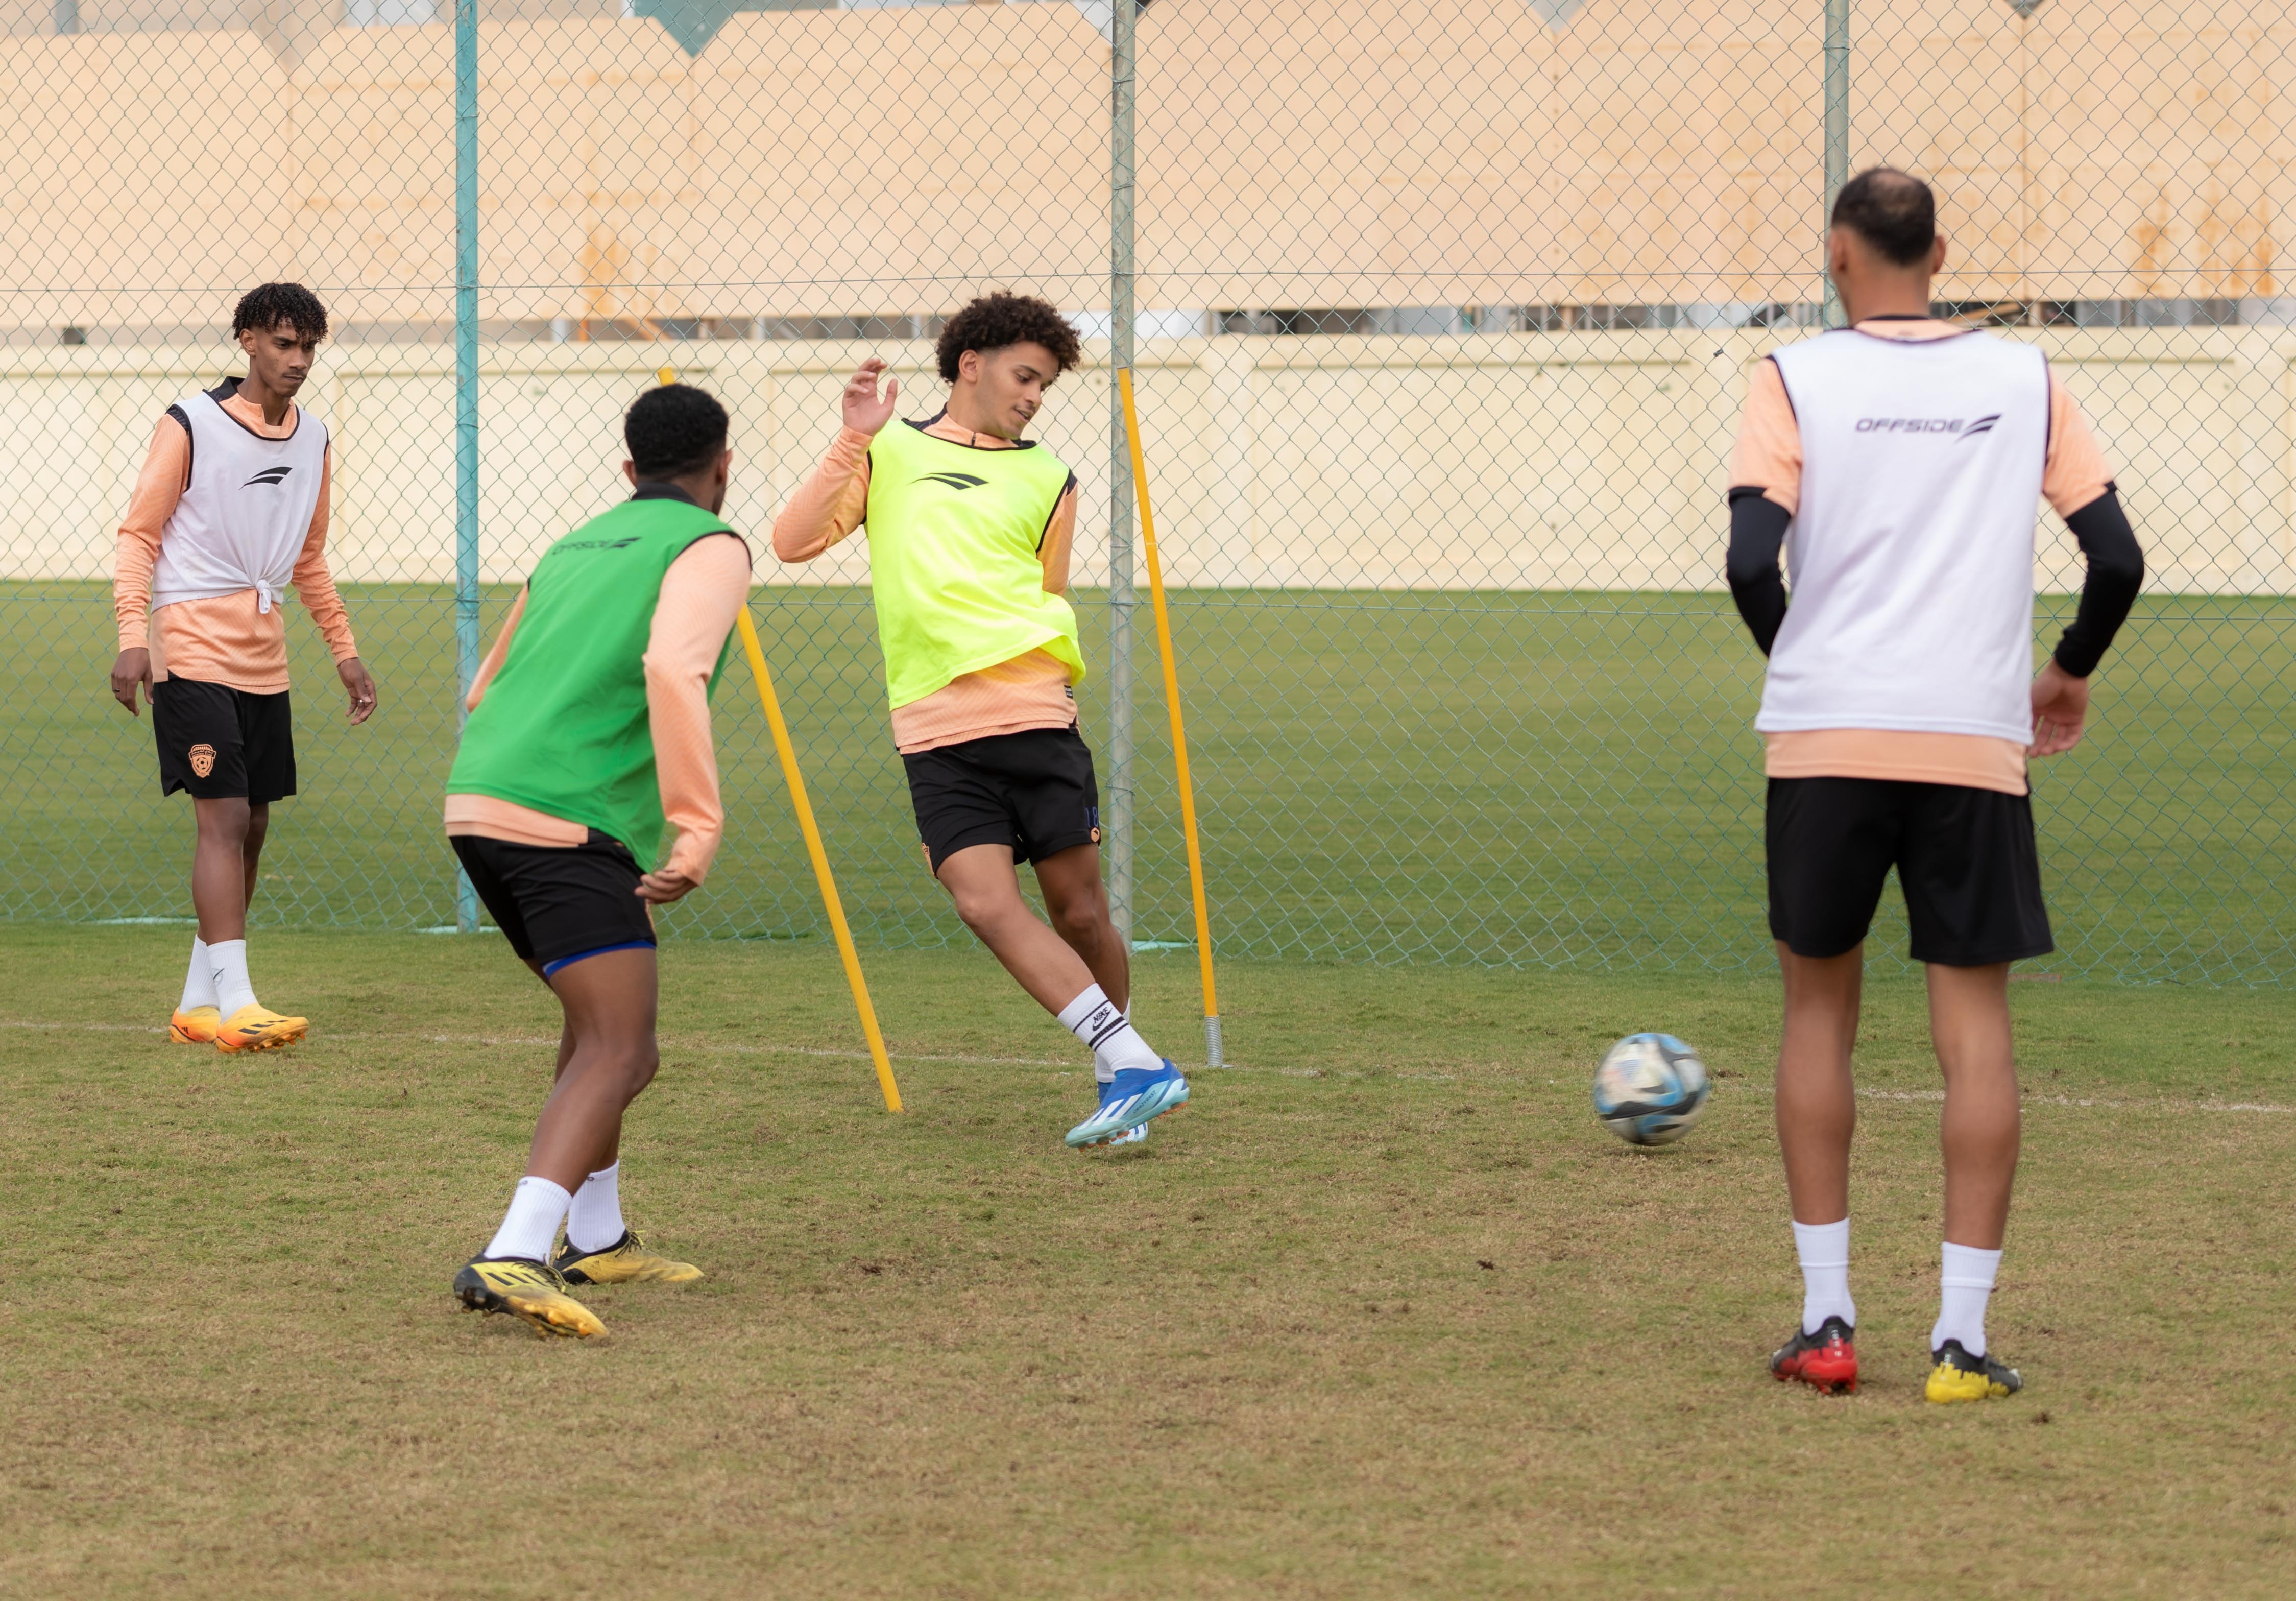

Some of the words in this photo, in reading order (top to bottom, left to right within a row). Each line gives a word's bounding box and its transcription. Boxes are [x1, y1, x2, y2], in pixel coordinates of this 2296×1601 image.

[1855, 418, 1964, 433] OFFSIDE
[1086, 806, 1098, 828] 18
[1093, 1007, 1108, 1024] NIKE
